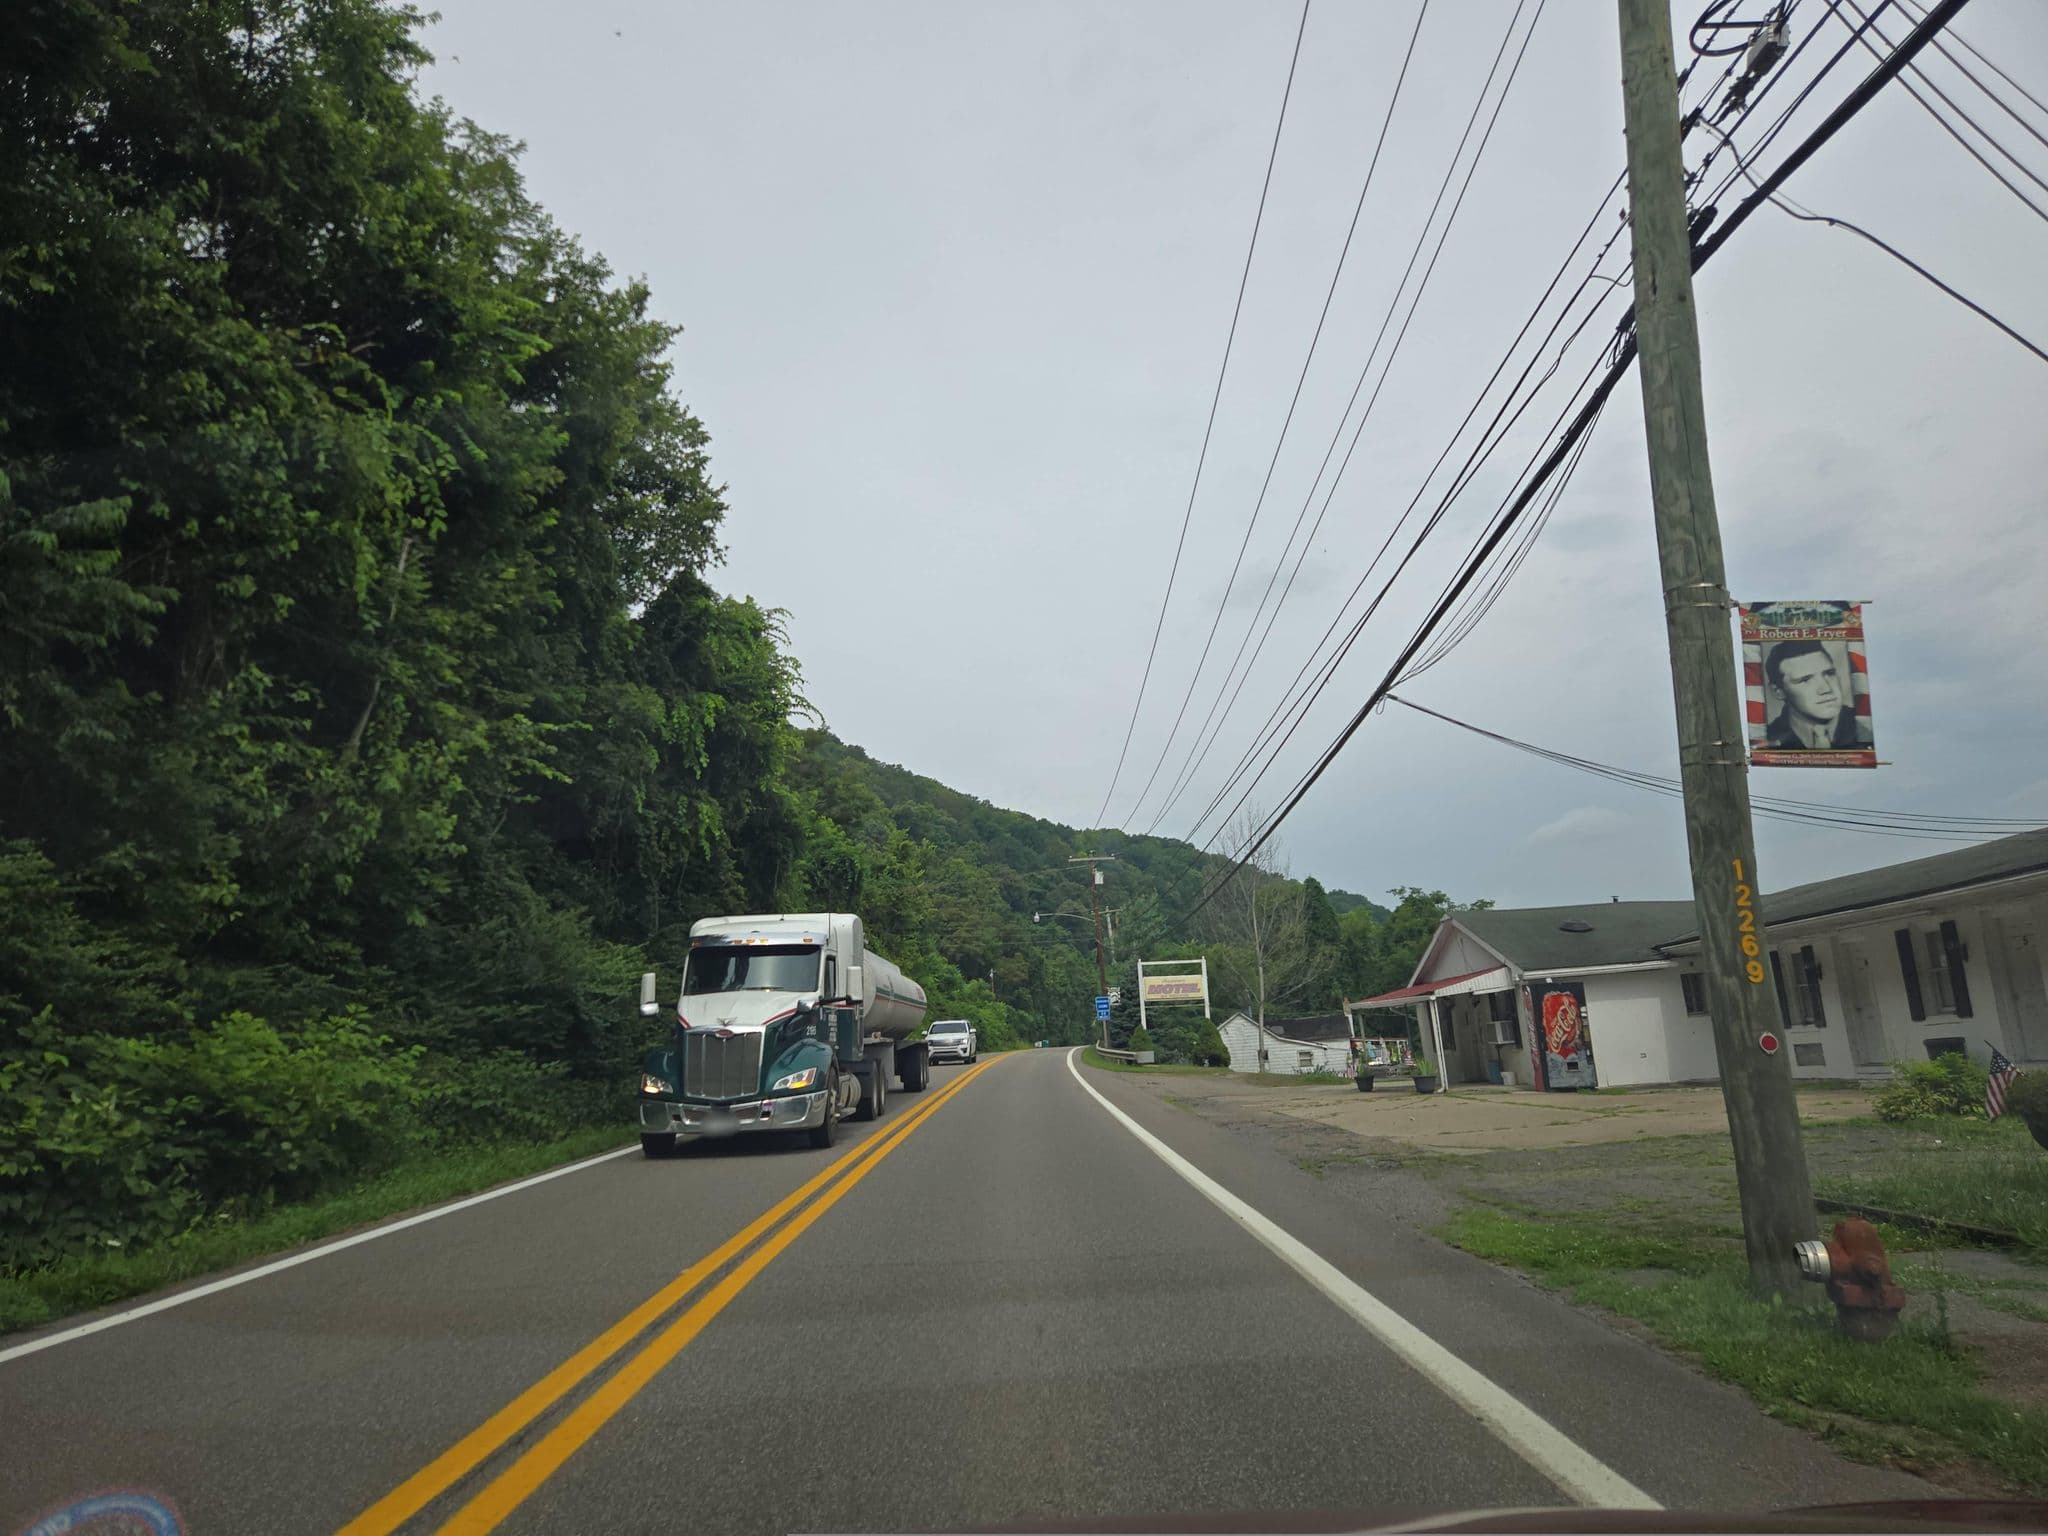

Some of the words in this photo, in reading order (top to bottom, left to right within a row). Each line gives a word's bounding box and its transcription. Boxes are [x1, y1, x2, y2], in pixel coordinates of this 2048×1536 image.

[1760, 629, 1799, 639] Robert
[1803, 629, 1814, 639] E.
[1817, 629, 1847, 641] Fryer
[1732, 858, 1765, 984] 12269
[2022, 935, 2029, 946] 5
[1147, 983, 1200, 994] MOTEL
